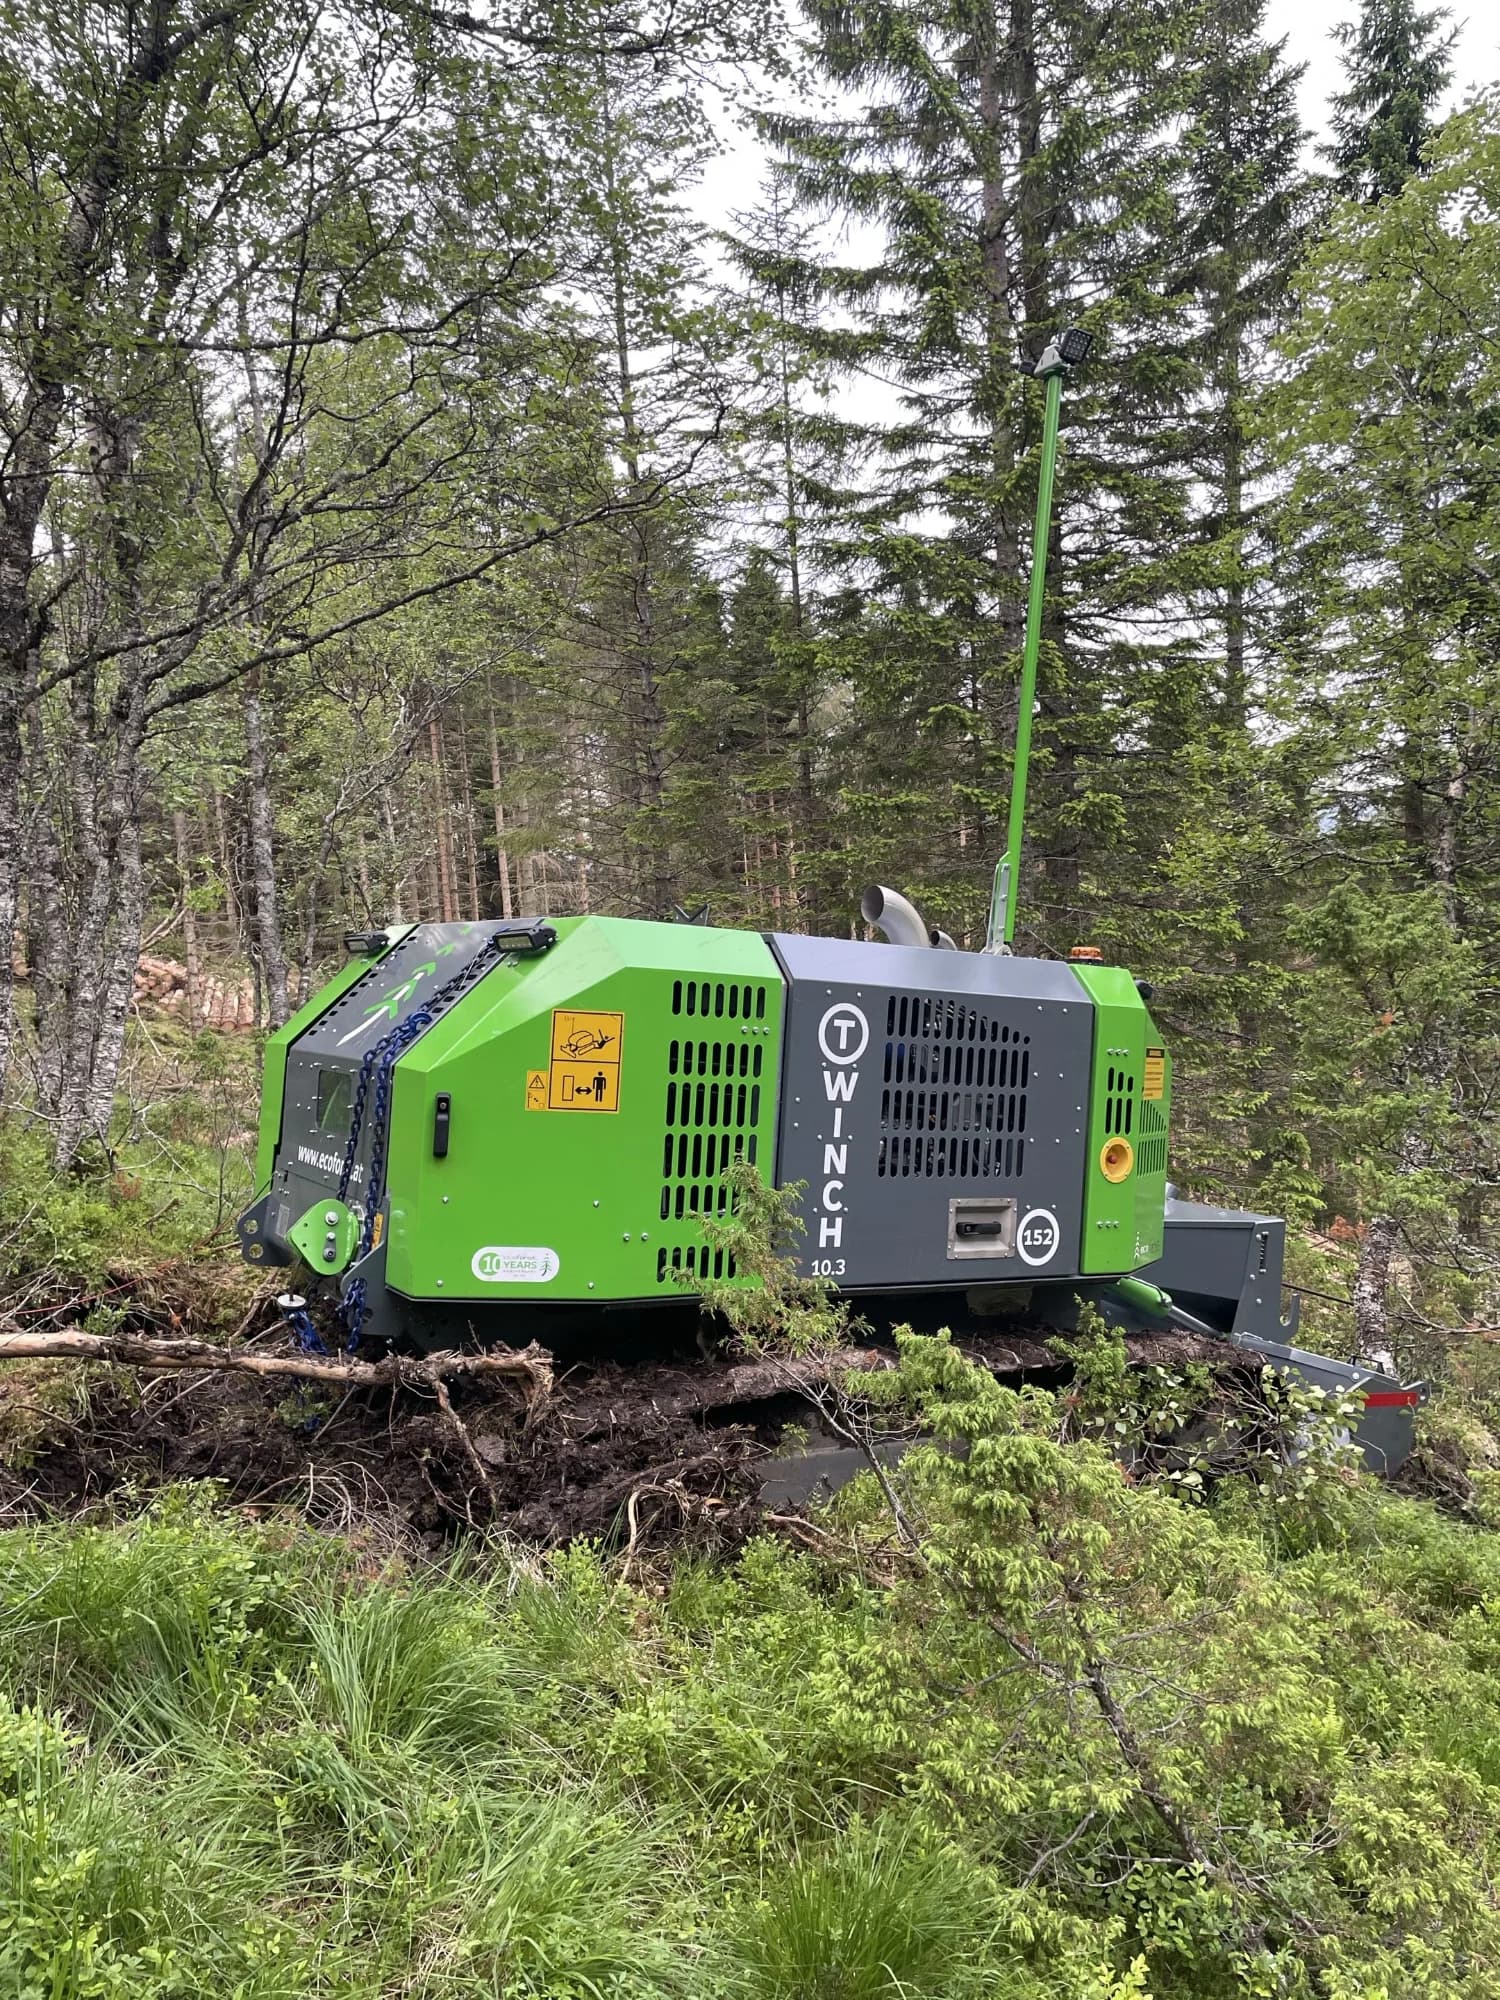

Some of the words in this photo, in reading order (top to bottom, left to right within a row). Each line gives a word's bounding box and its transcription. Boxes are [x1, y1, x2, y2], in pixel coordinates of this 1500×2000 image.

[298, 1145, 364, 1184] www.ecofor.at
[1023, 1228, 1053, 1246] 152
[483, 1255, 501, 1273] 10
[503, 1261, 537, 1269] YEARS
[811, 1259, 846, 1276] 10.3
